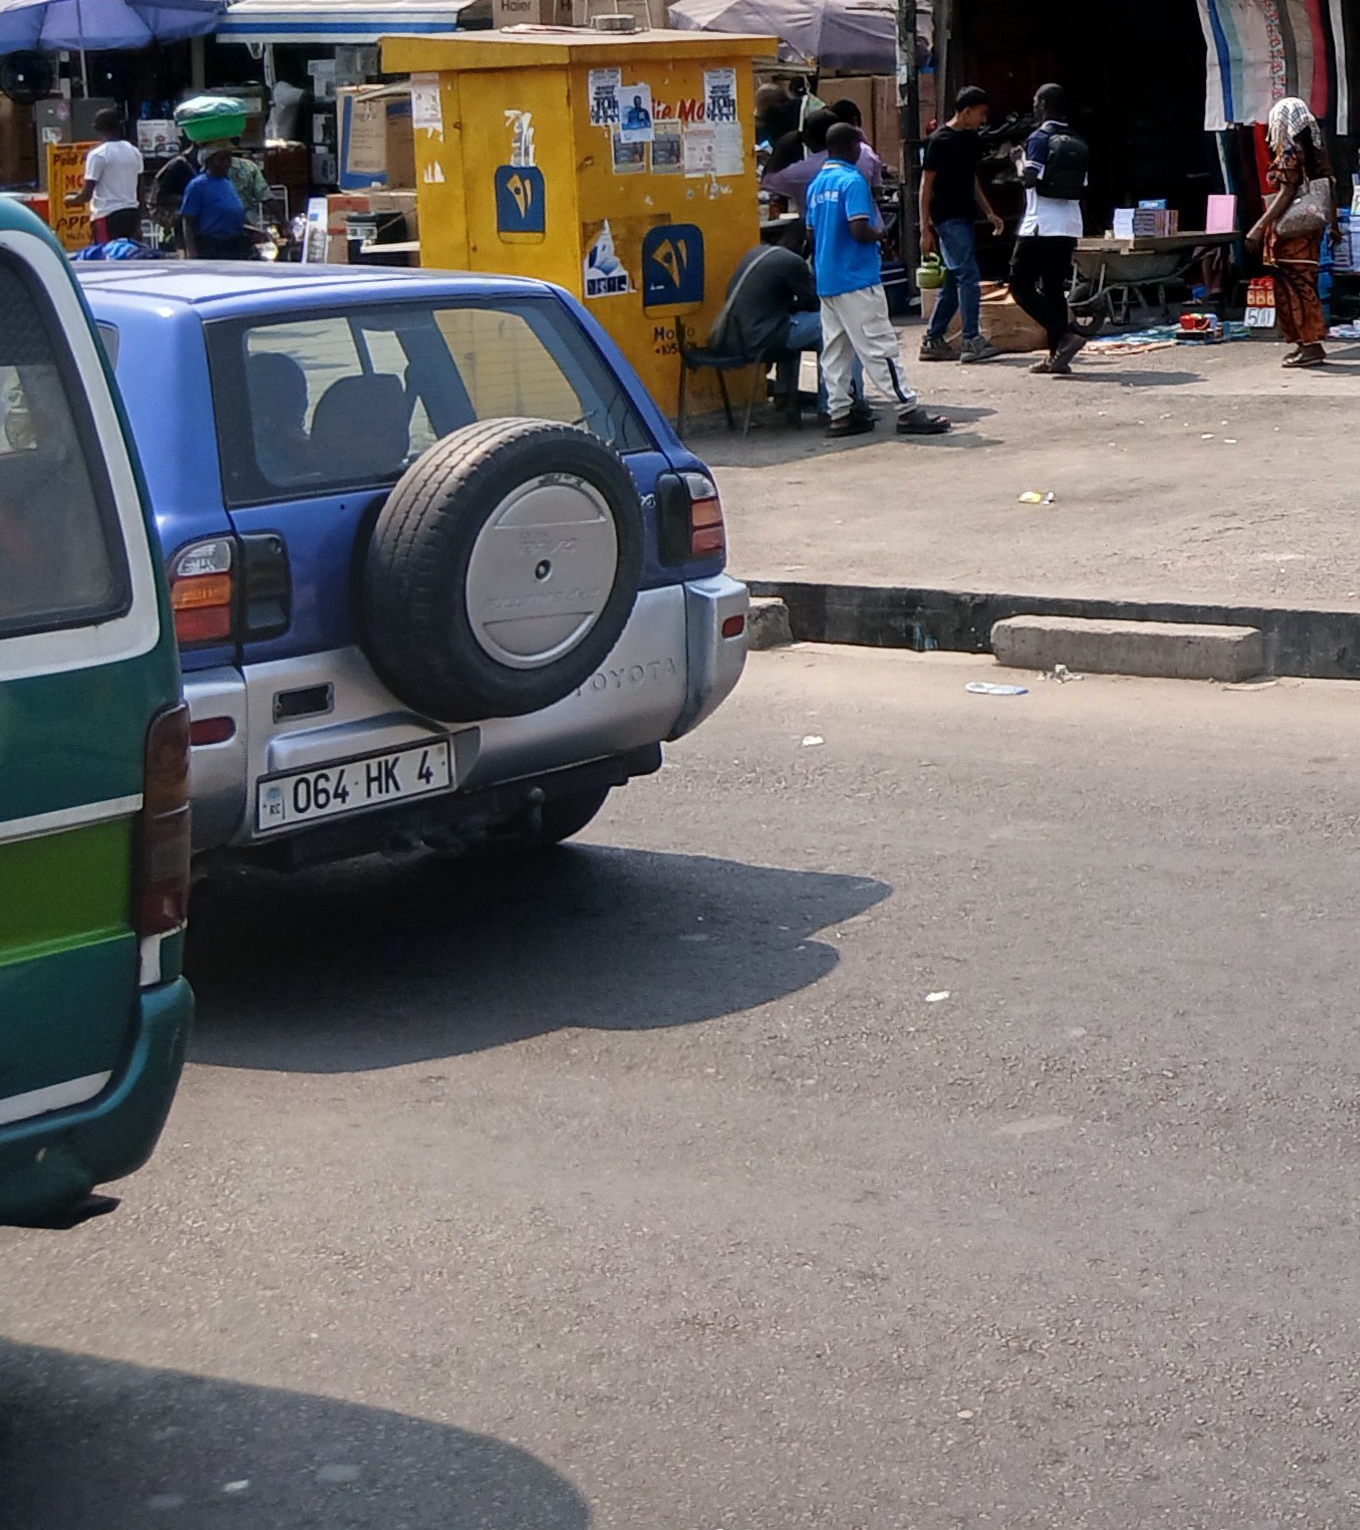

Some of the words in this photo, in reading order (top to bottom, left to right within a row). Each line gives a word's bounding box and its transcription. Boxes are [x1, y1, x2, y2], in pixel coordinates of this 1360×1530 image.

[293, 768, 350, 814] 064
[366, 756, 401, 799] HK
[416, 750, 434, 785] 4
